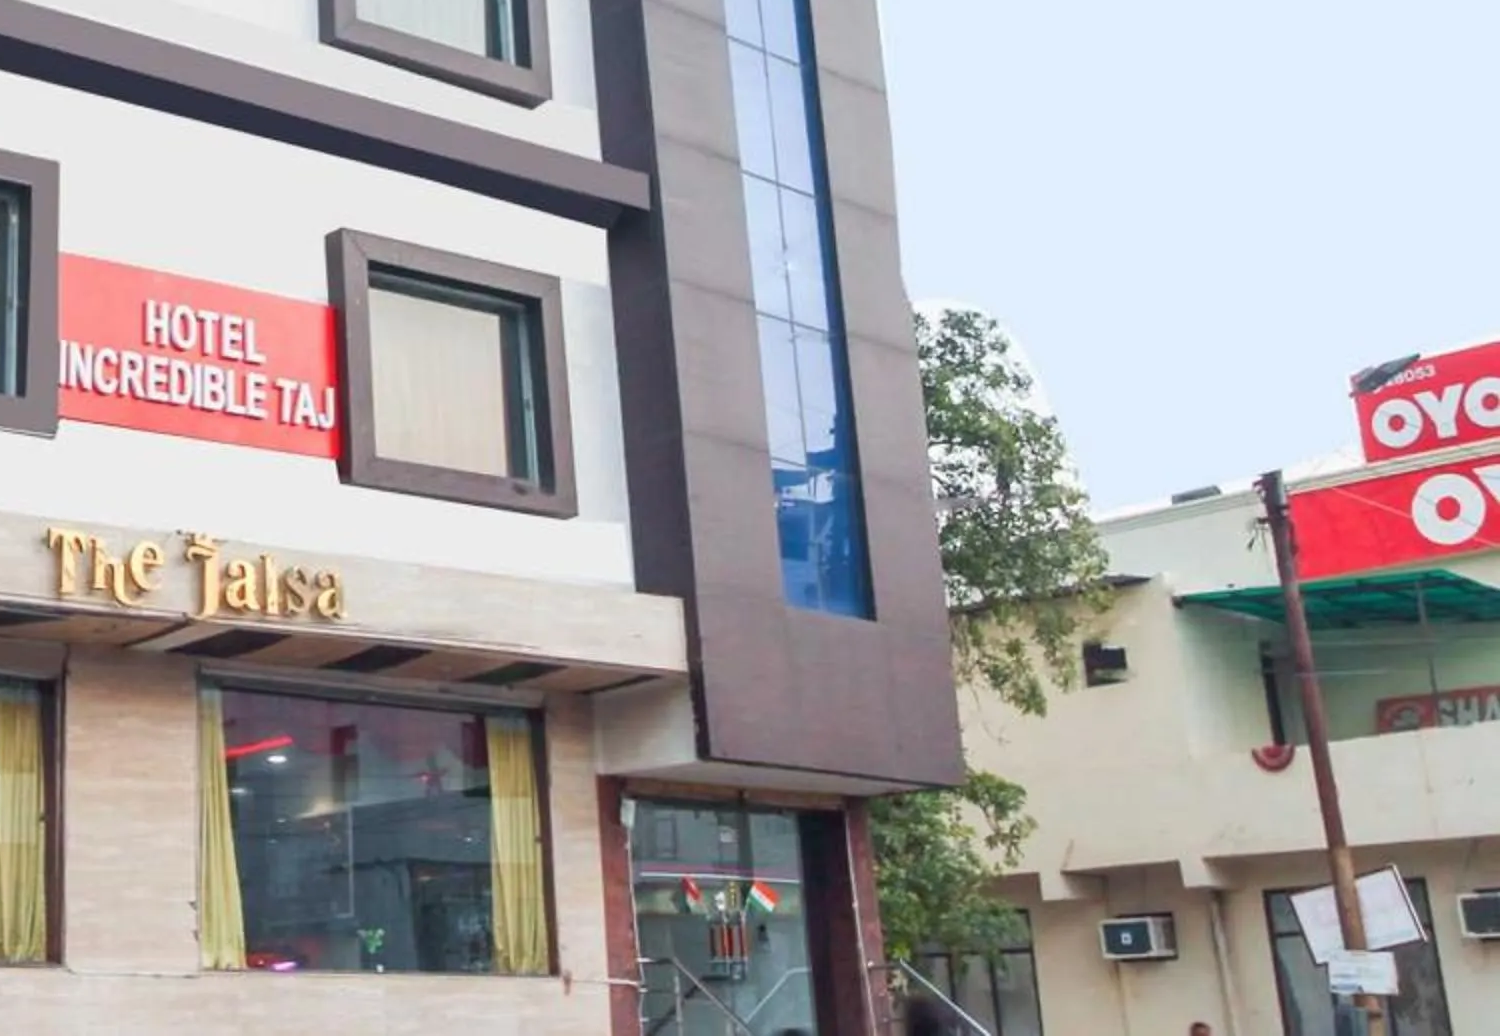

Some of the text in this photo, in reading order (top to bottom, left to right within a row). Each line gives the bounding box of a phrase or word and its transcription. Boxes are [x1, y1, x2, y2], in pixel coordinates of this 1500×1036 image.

[145, 300, 267, 363] HOTEL
[58, 340, 335, 429] INCREDIBLE TAJ
[1372, 376, 1500, 449] OYO
[1412, 464, 1500, 545] O
[47, 527, 349, 620] The Jalsa
